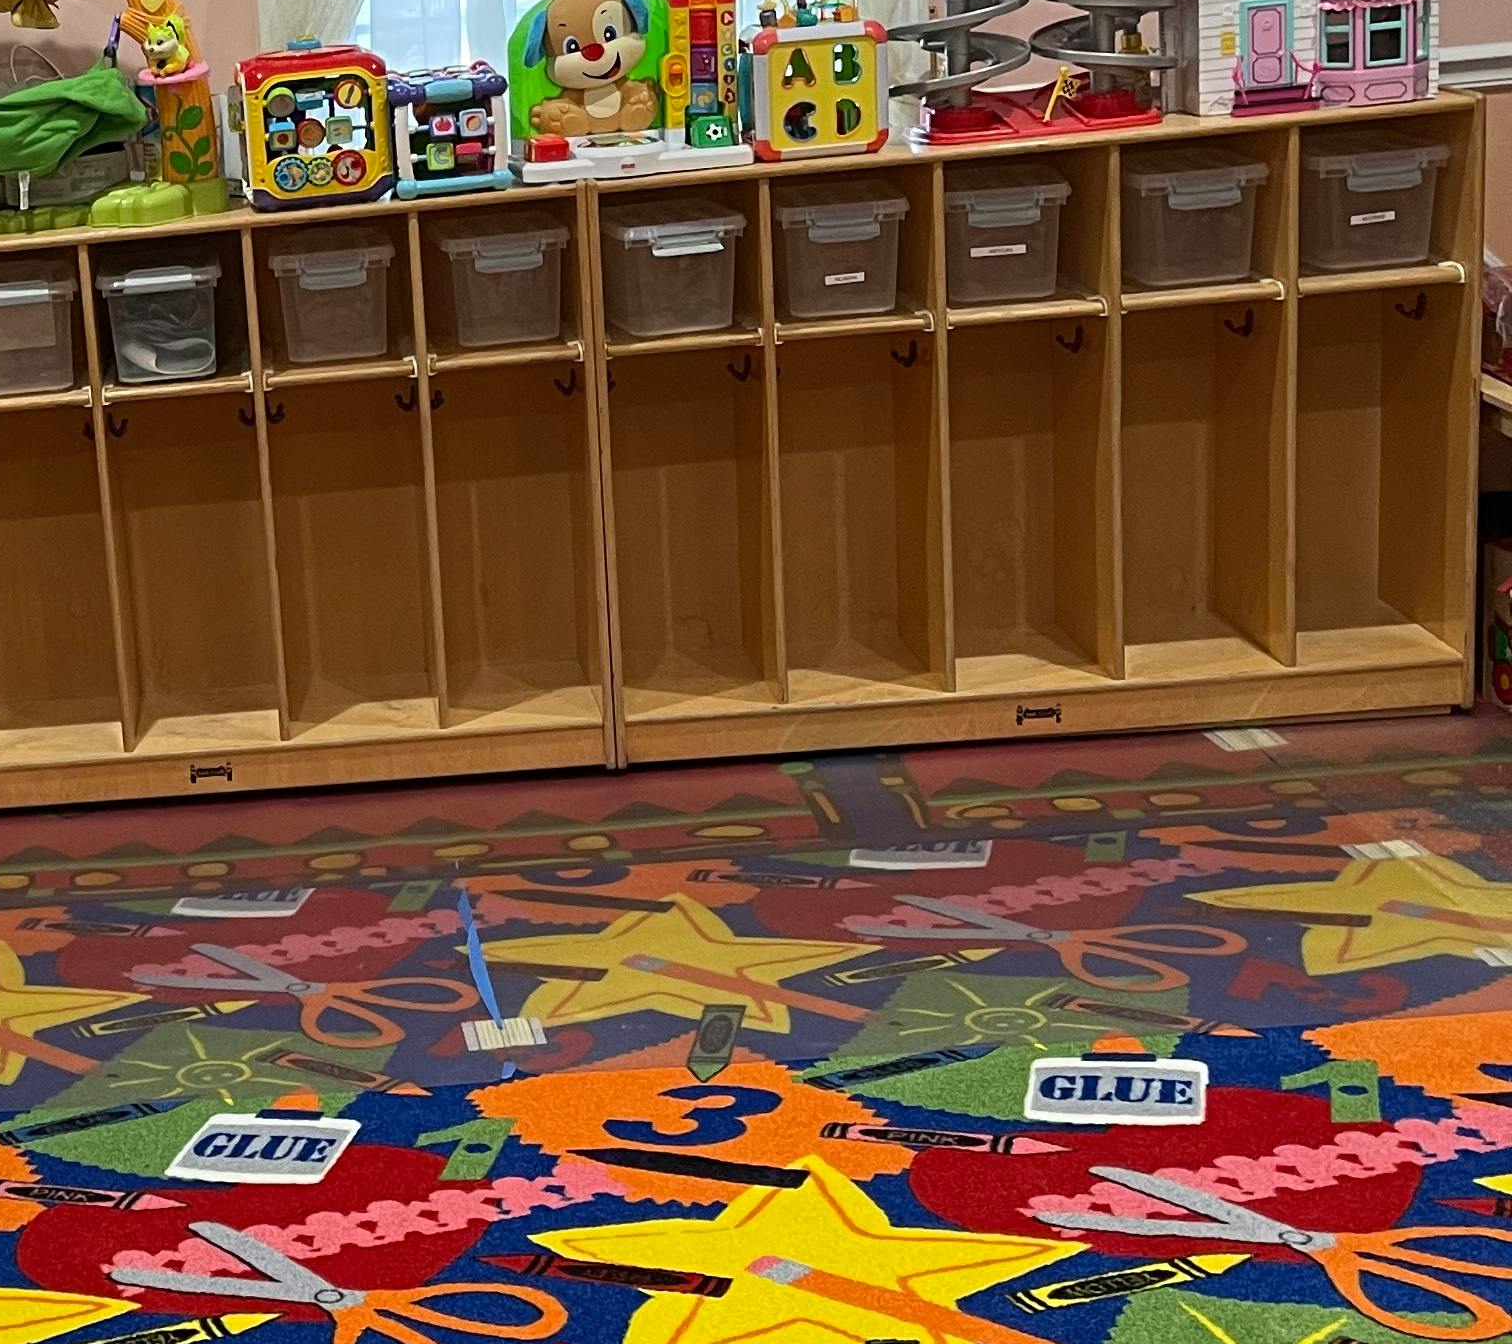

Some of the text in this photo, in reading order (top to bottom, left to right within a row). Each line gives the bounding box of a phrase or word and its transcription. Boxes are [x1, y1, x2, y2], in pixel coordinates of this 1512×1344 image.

[782, 48, 816, 90] A
[833, 41, 863, 85] B
[784, 101, 817, 142] C
[835, 98, 862, 138] D
[1039, 1075, 1193, 1106] GLUE
[1281, 1059, 1382, 1124] 1
[602, 1085, 783, 1146] 3
[192, 1132, 336, 1163] GLUE
[416, 1117, 516, 1181] 1
[888, 1129, 962, 1147] PINK
[29, 1185, 98, 1204] PINK
